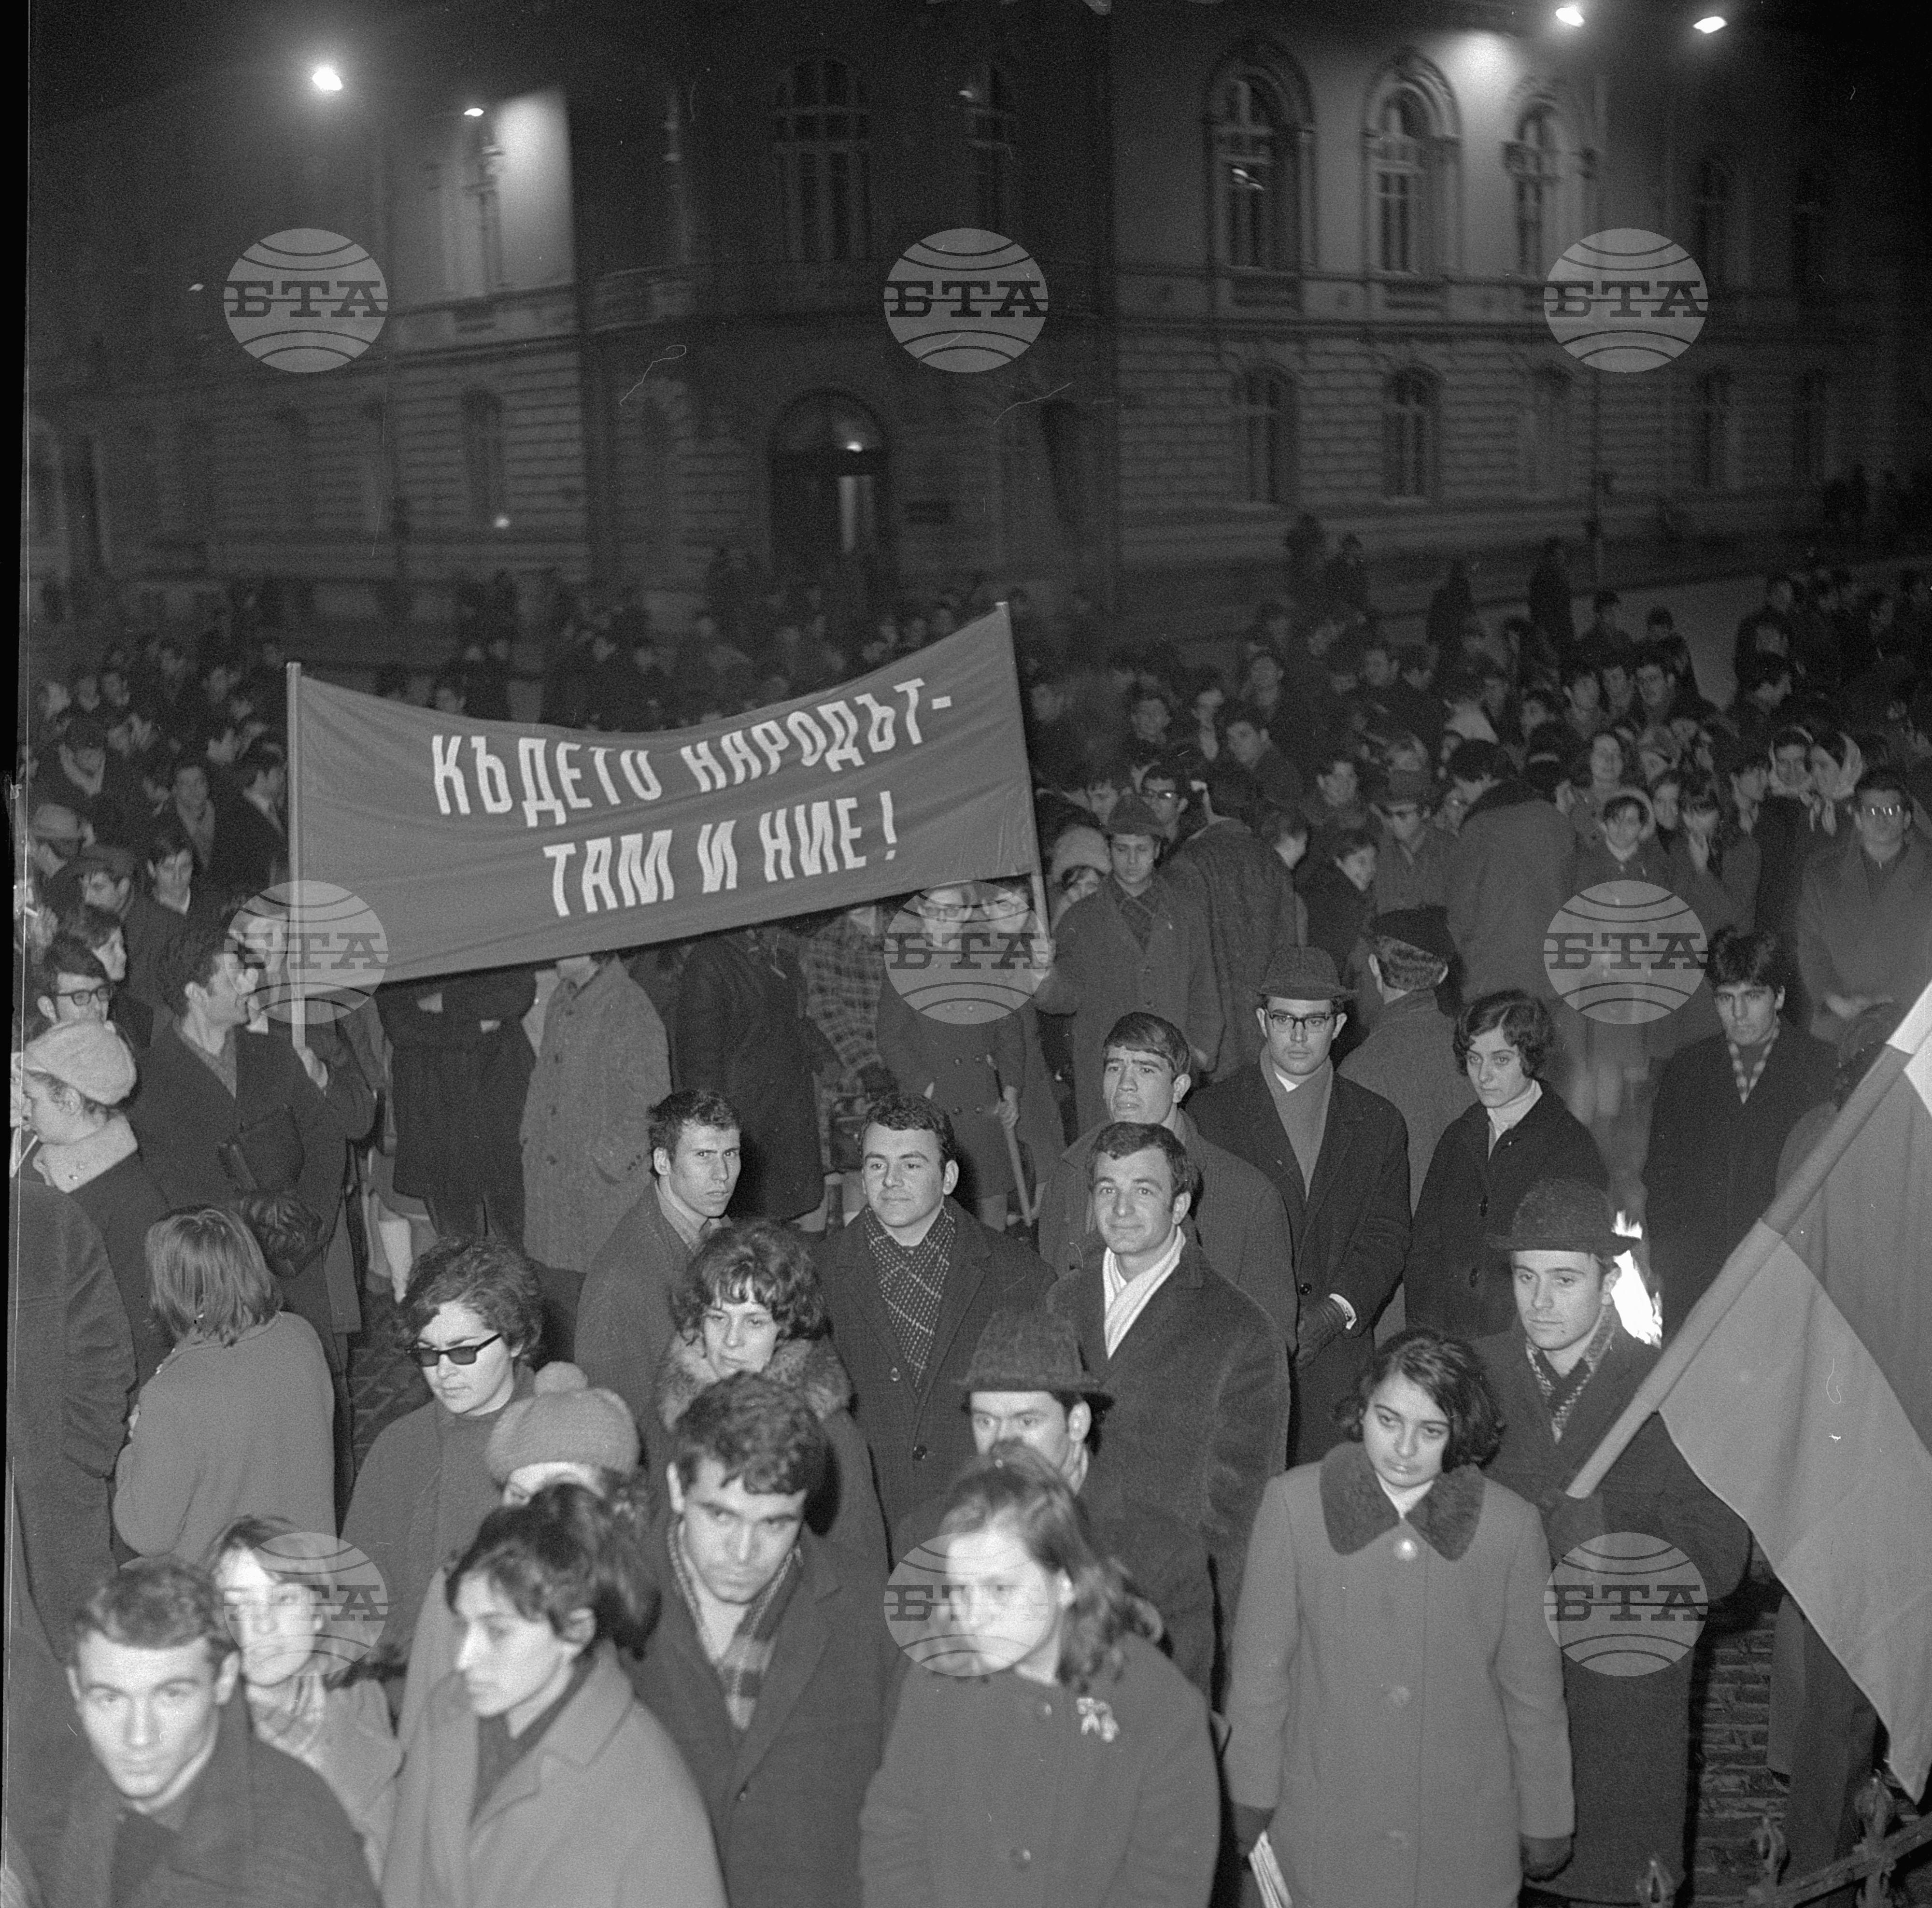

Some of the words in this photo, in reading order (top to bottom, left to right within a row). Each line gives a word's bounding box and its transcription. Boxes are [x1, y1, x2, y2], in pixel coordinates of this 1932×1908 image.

[432, 735, 662, 828] КЪДЕТО
[680, 678, 952, 792] НАРОДЪТ-
[542, 829, 675, 918] ТАМ
[697, 820, 738, 894] И
[758, 790, 897, 882] НИЕ!
